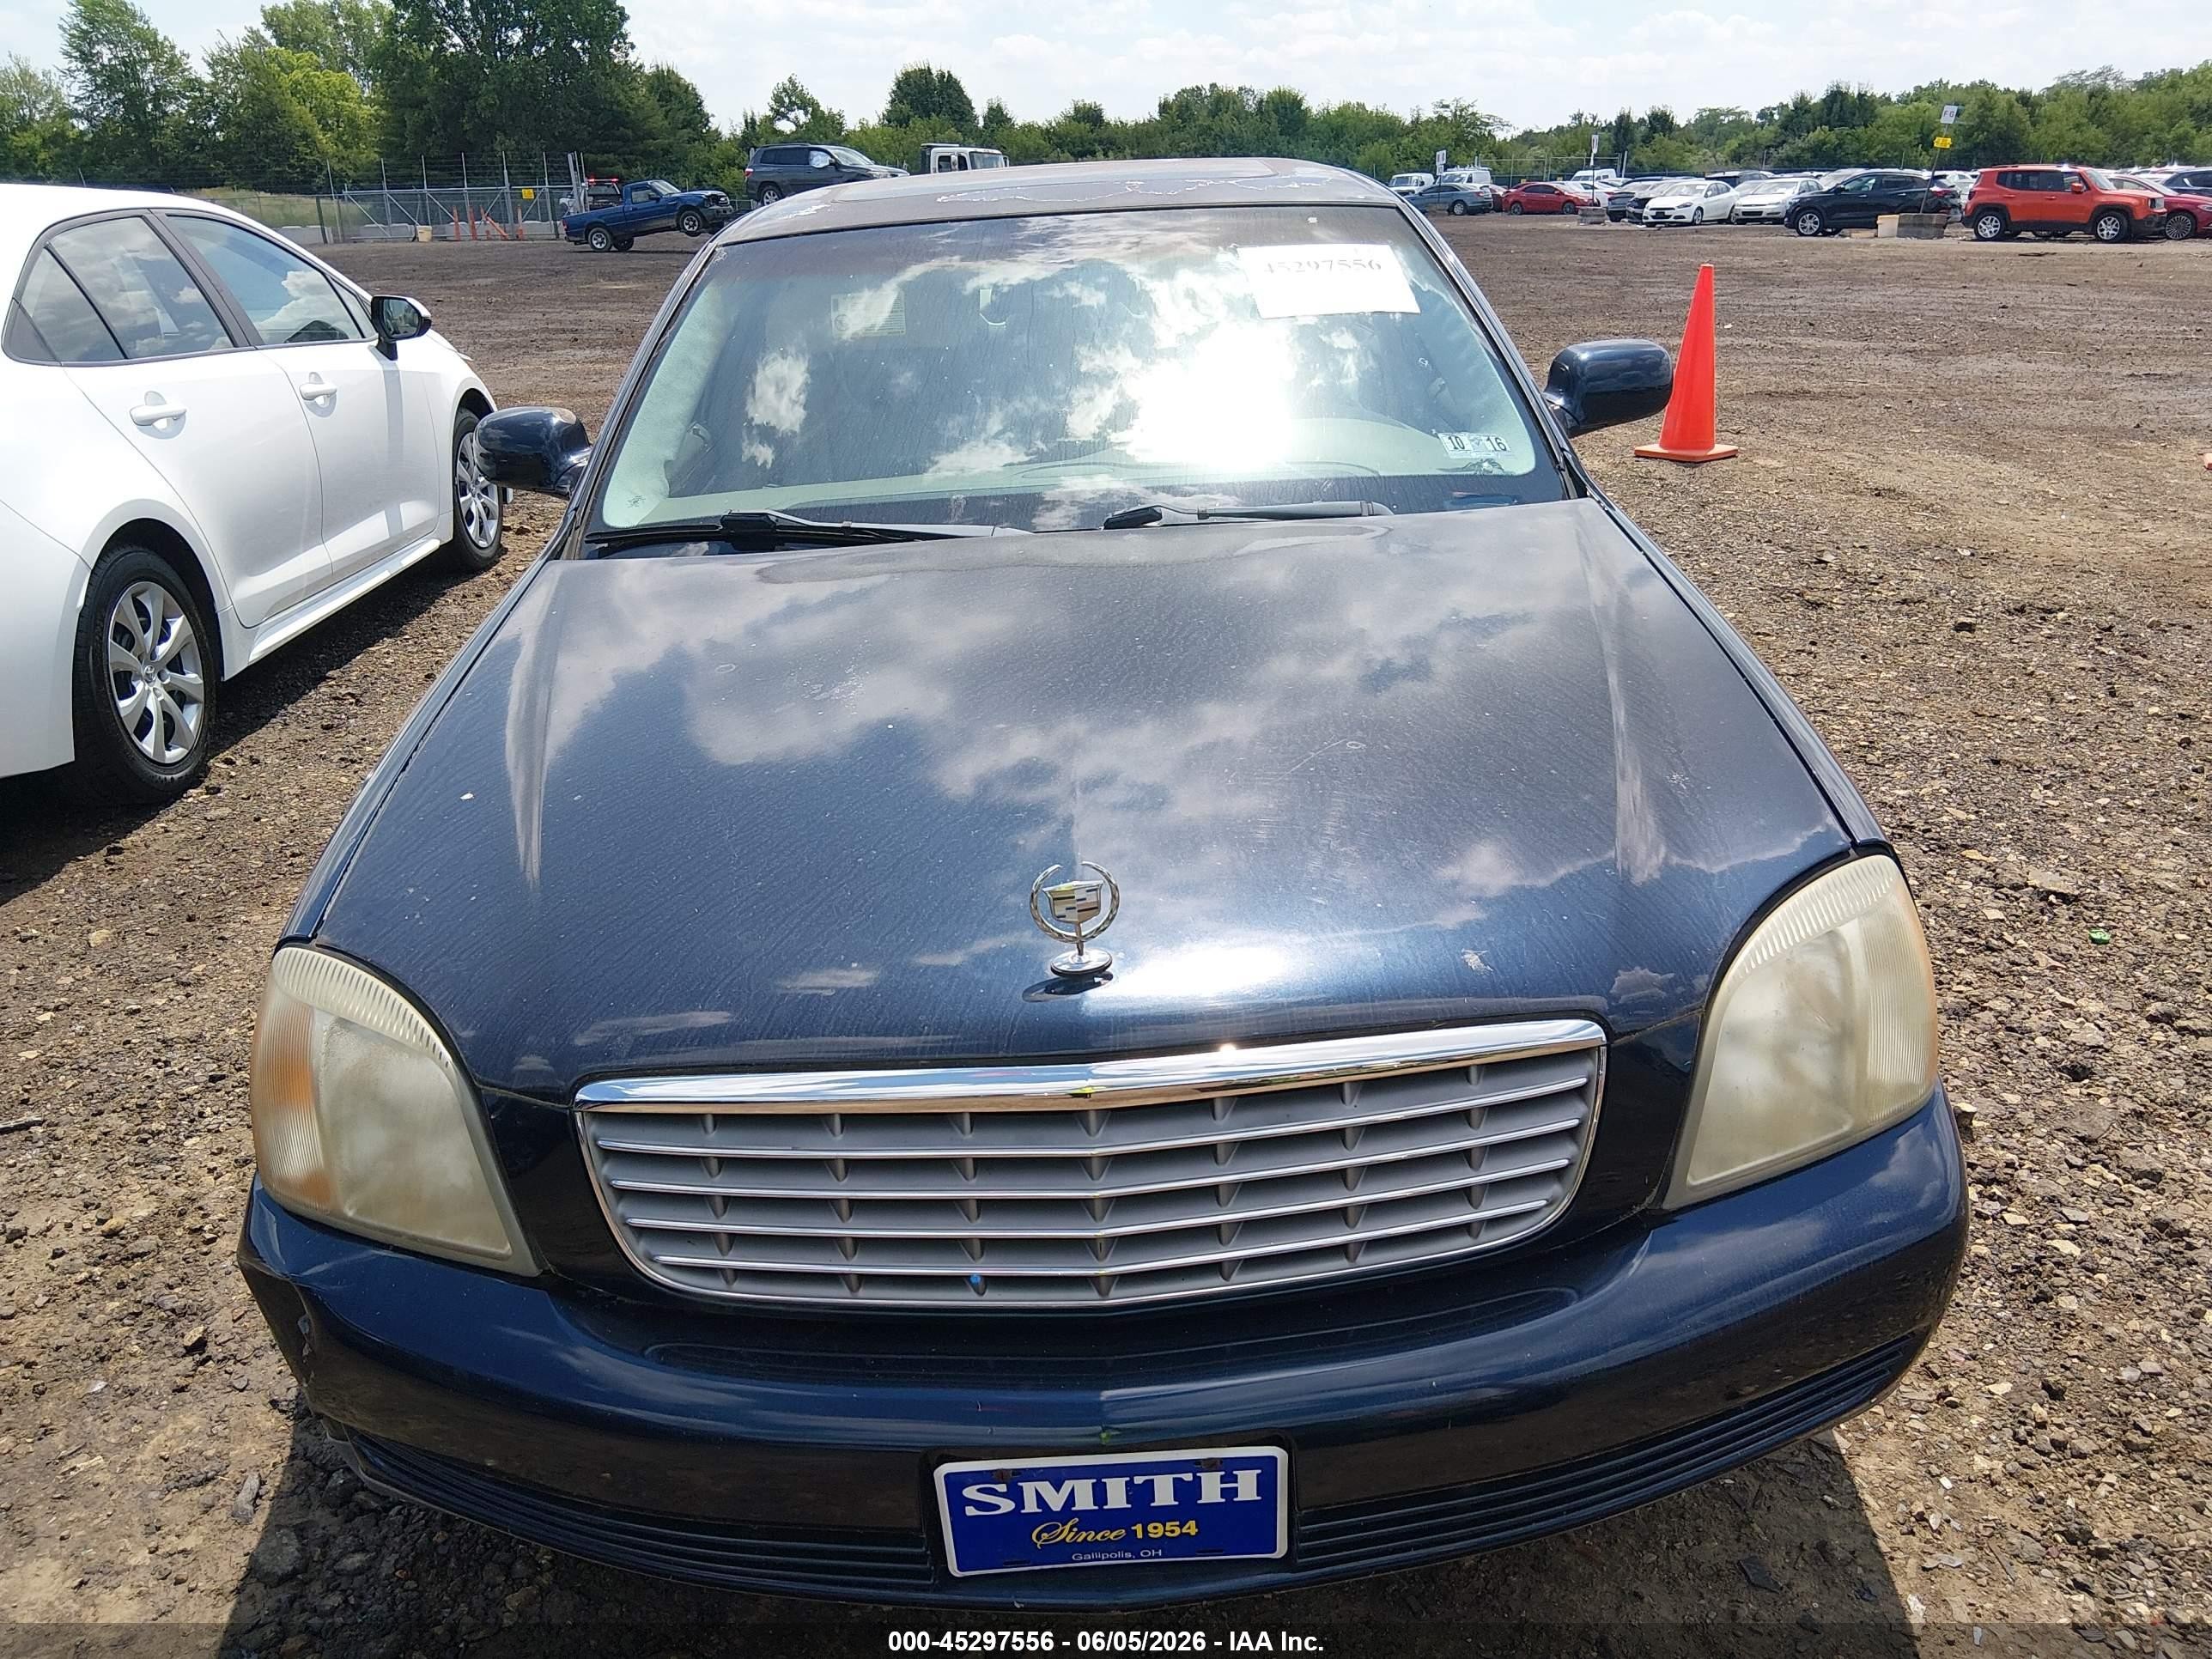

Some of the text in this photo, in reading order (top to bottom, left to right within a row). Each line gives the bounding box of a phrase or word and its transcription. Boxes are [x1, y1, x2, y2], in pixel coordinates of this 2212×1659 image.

[1449, 435, 1507, 452] 10 16
[961, 1468, 1263, 1516] SMITH
[1031, 1517, 1199, 1549] Since 1954
[1072, 1548, 1163, 1562] Gallipolis, OH
